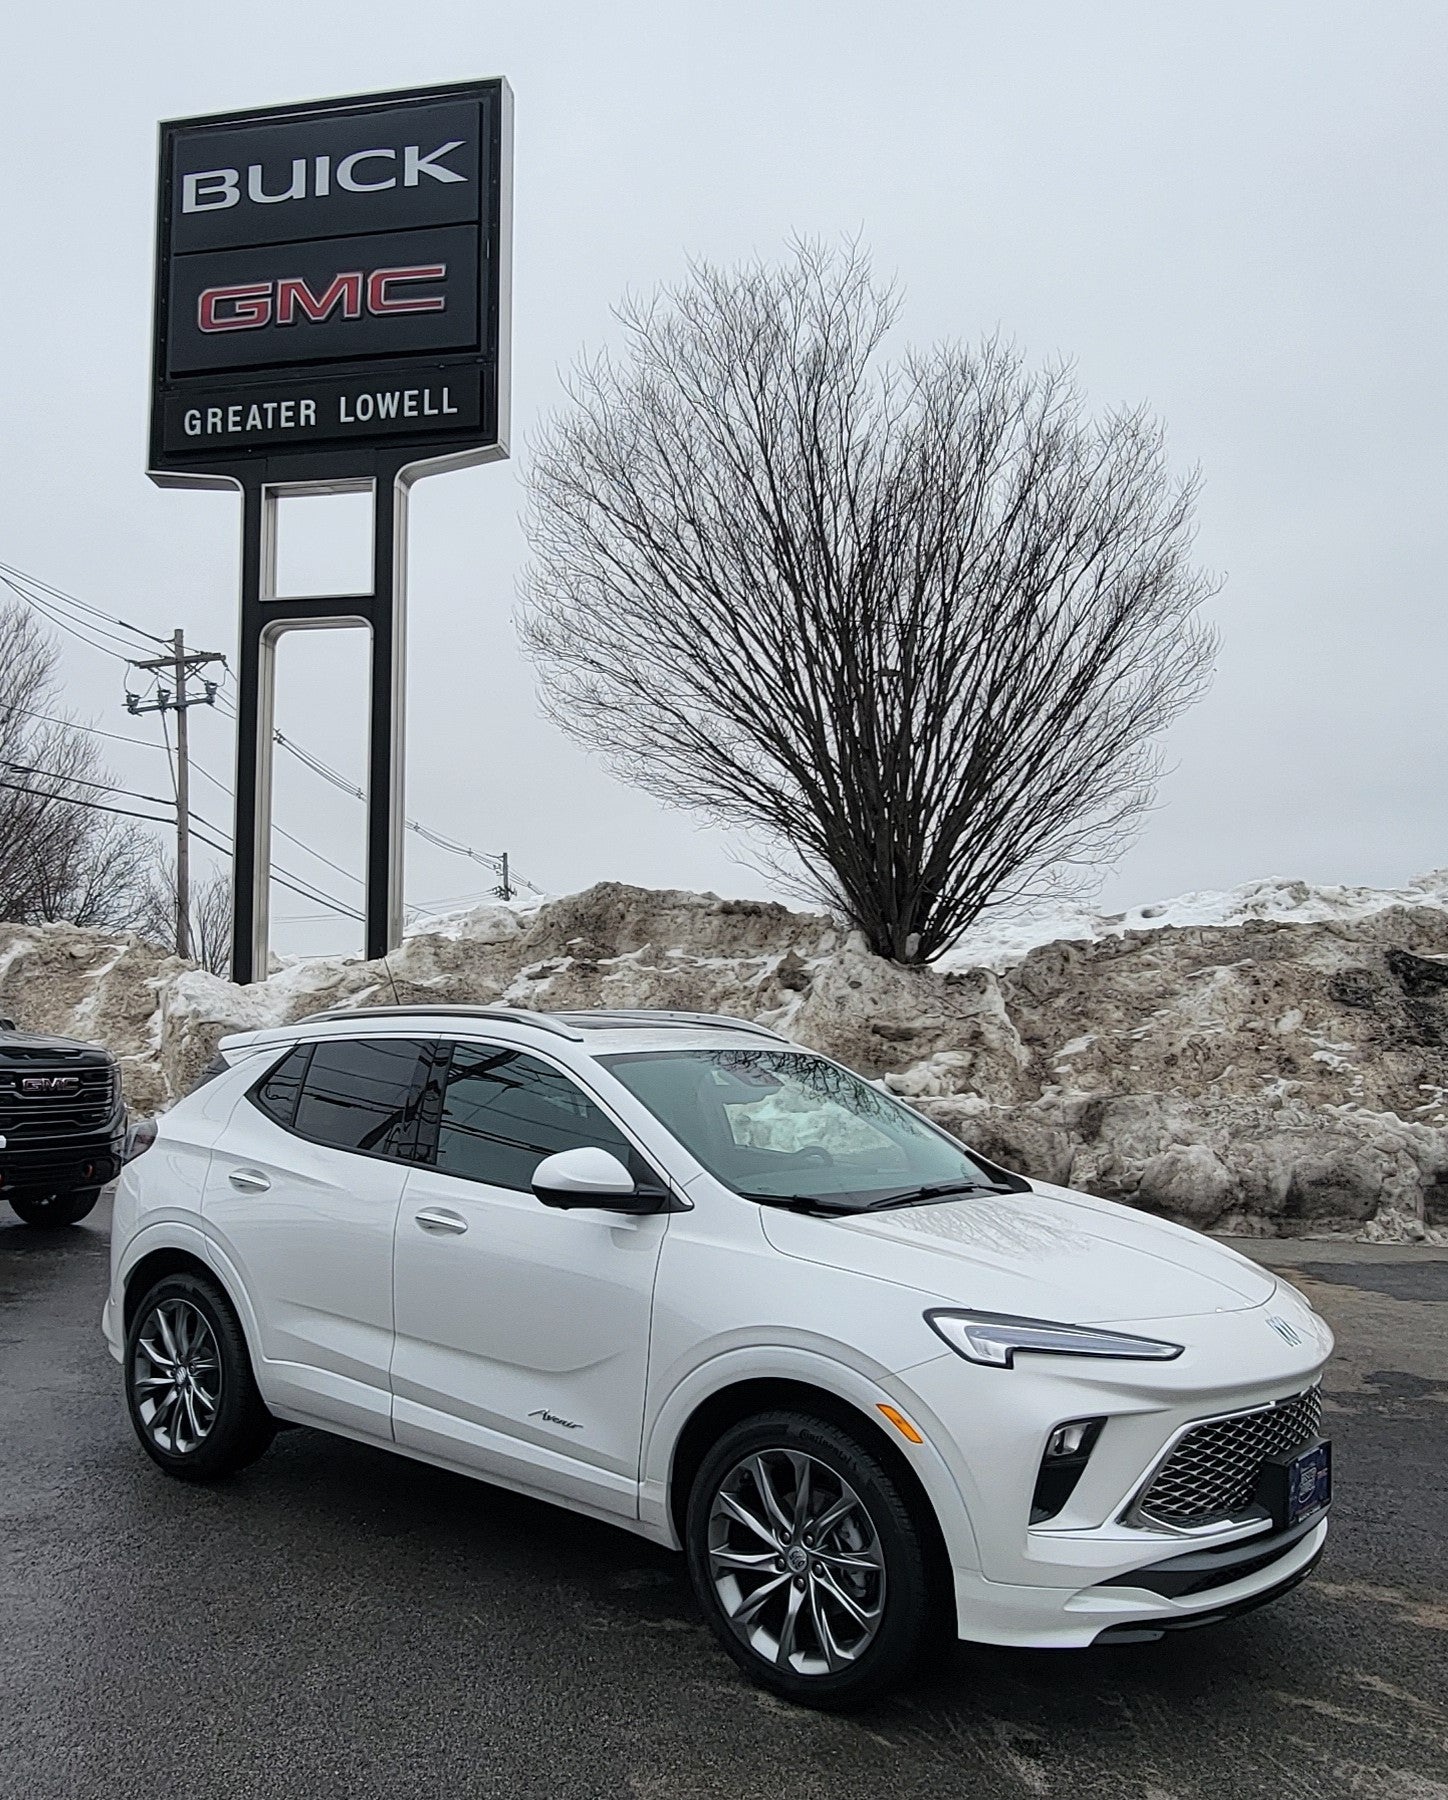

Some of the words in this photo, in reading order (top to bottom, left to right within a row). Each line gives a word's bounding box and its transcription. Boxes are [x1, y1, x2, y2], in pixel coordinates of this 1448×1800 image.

[181, 140, 469, 214] BUICK
[197, 263, 447, 334] GMC
[184, 399, 317, 436] GREATER
[339, 387, 458, 423] LOWELL
[22, 1077, 79, 1091] GMC
